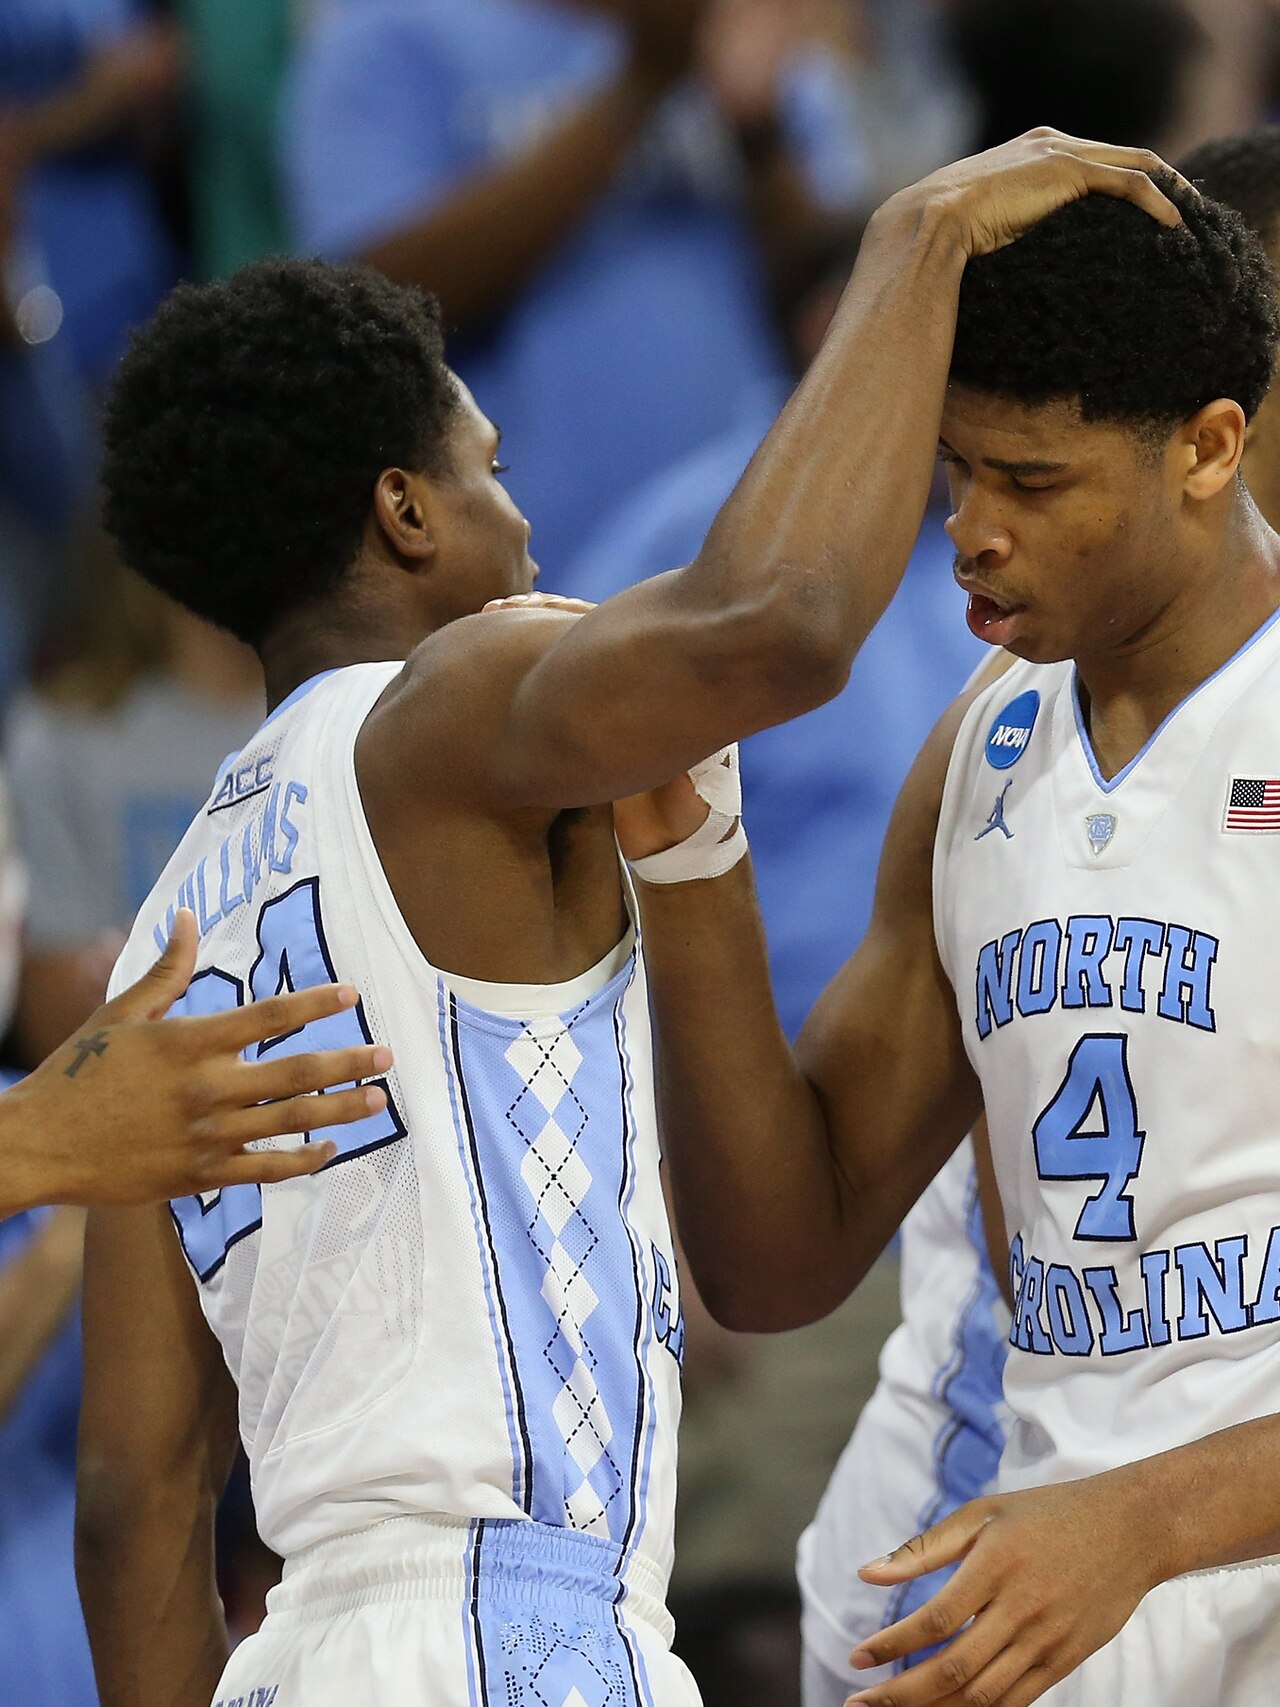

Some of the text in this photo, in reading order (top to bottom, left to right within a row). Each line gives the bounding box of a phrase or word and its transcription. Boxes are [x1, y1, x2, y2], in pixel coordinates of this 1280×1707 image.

[211, 754, 273, 806] ACC
[975, 915, 1220, 1041] NORTH
[1032, 1033, 1146, 1242] 4
